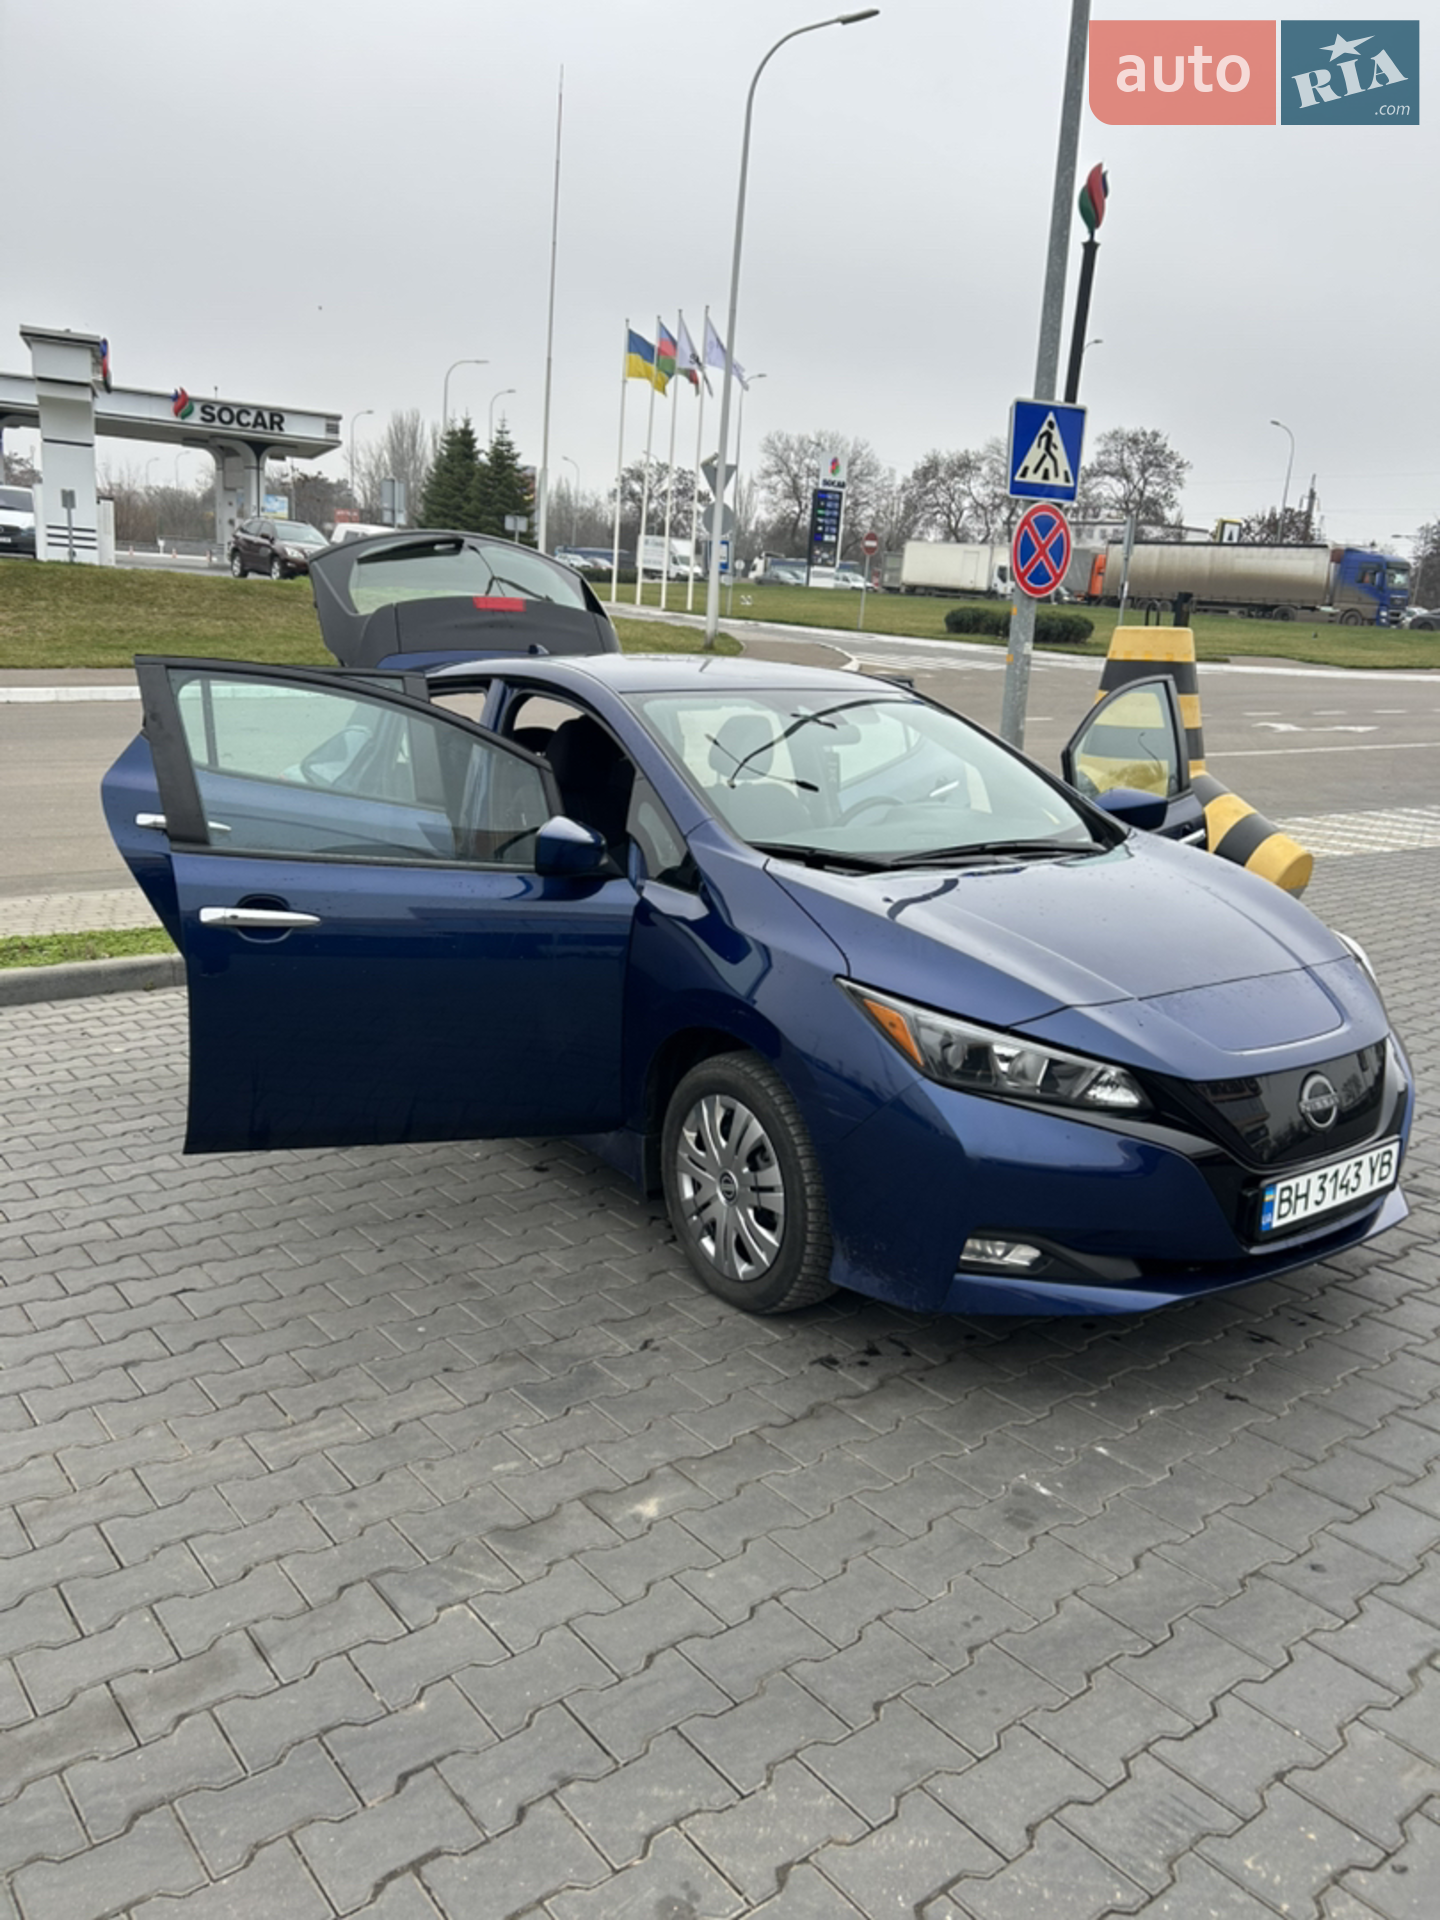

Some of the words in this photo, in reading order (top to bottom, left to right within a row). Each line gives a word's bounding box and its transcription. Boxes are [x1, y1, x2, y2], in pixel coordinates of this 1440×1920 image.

[200, 403, 285, 432] SOCAR
[1277, 1178, 1311, 1220] BH
[1314, 1160, 1363, 1206] 3143
[1369, 1149, 1393, 1186] YB
